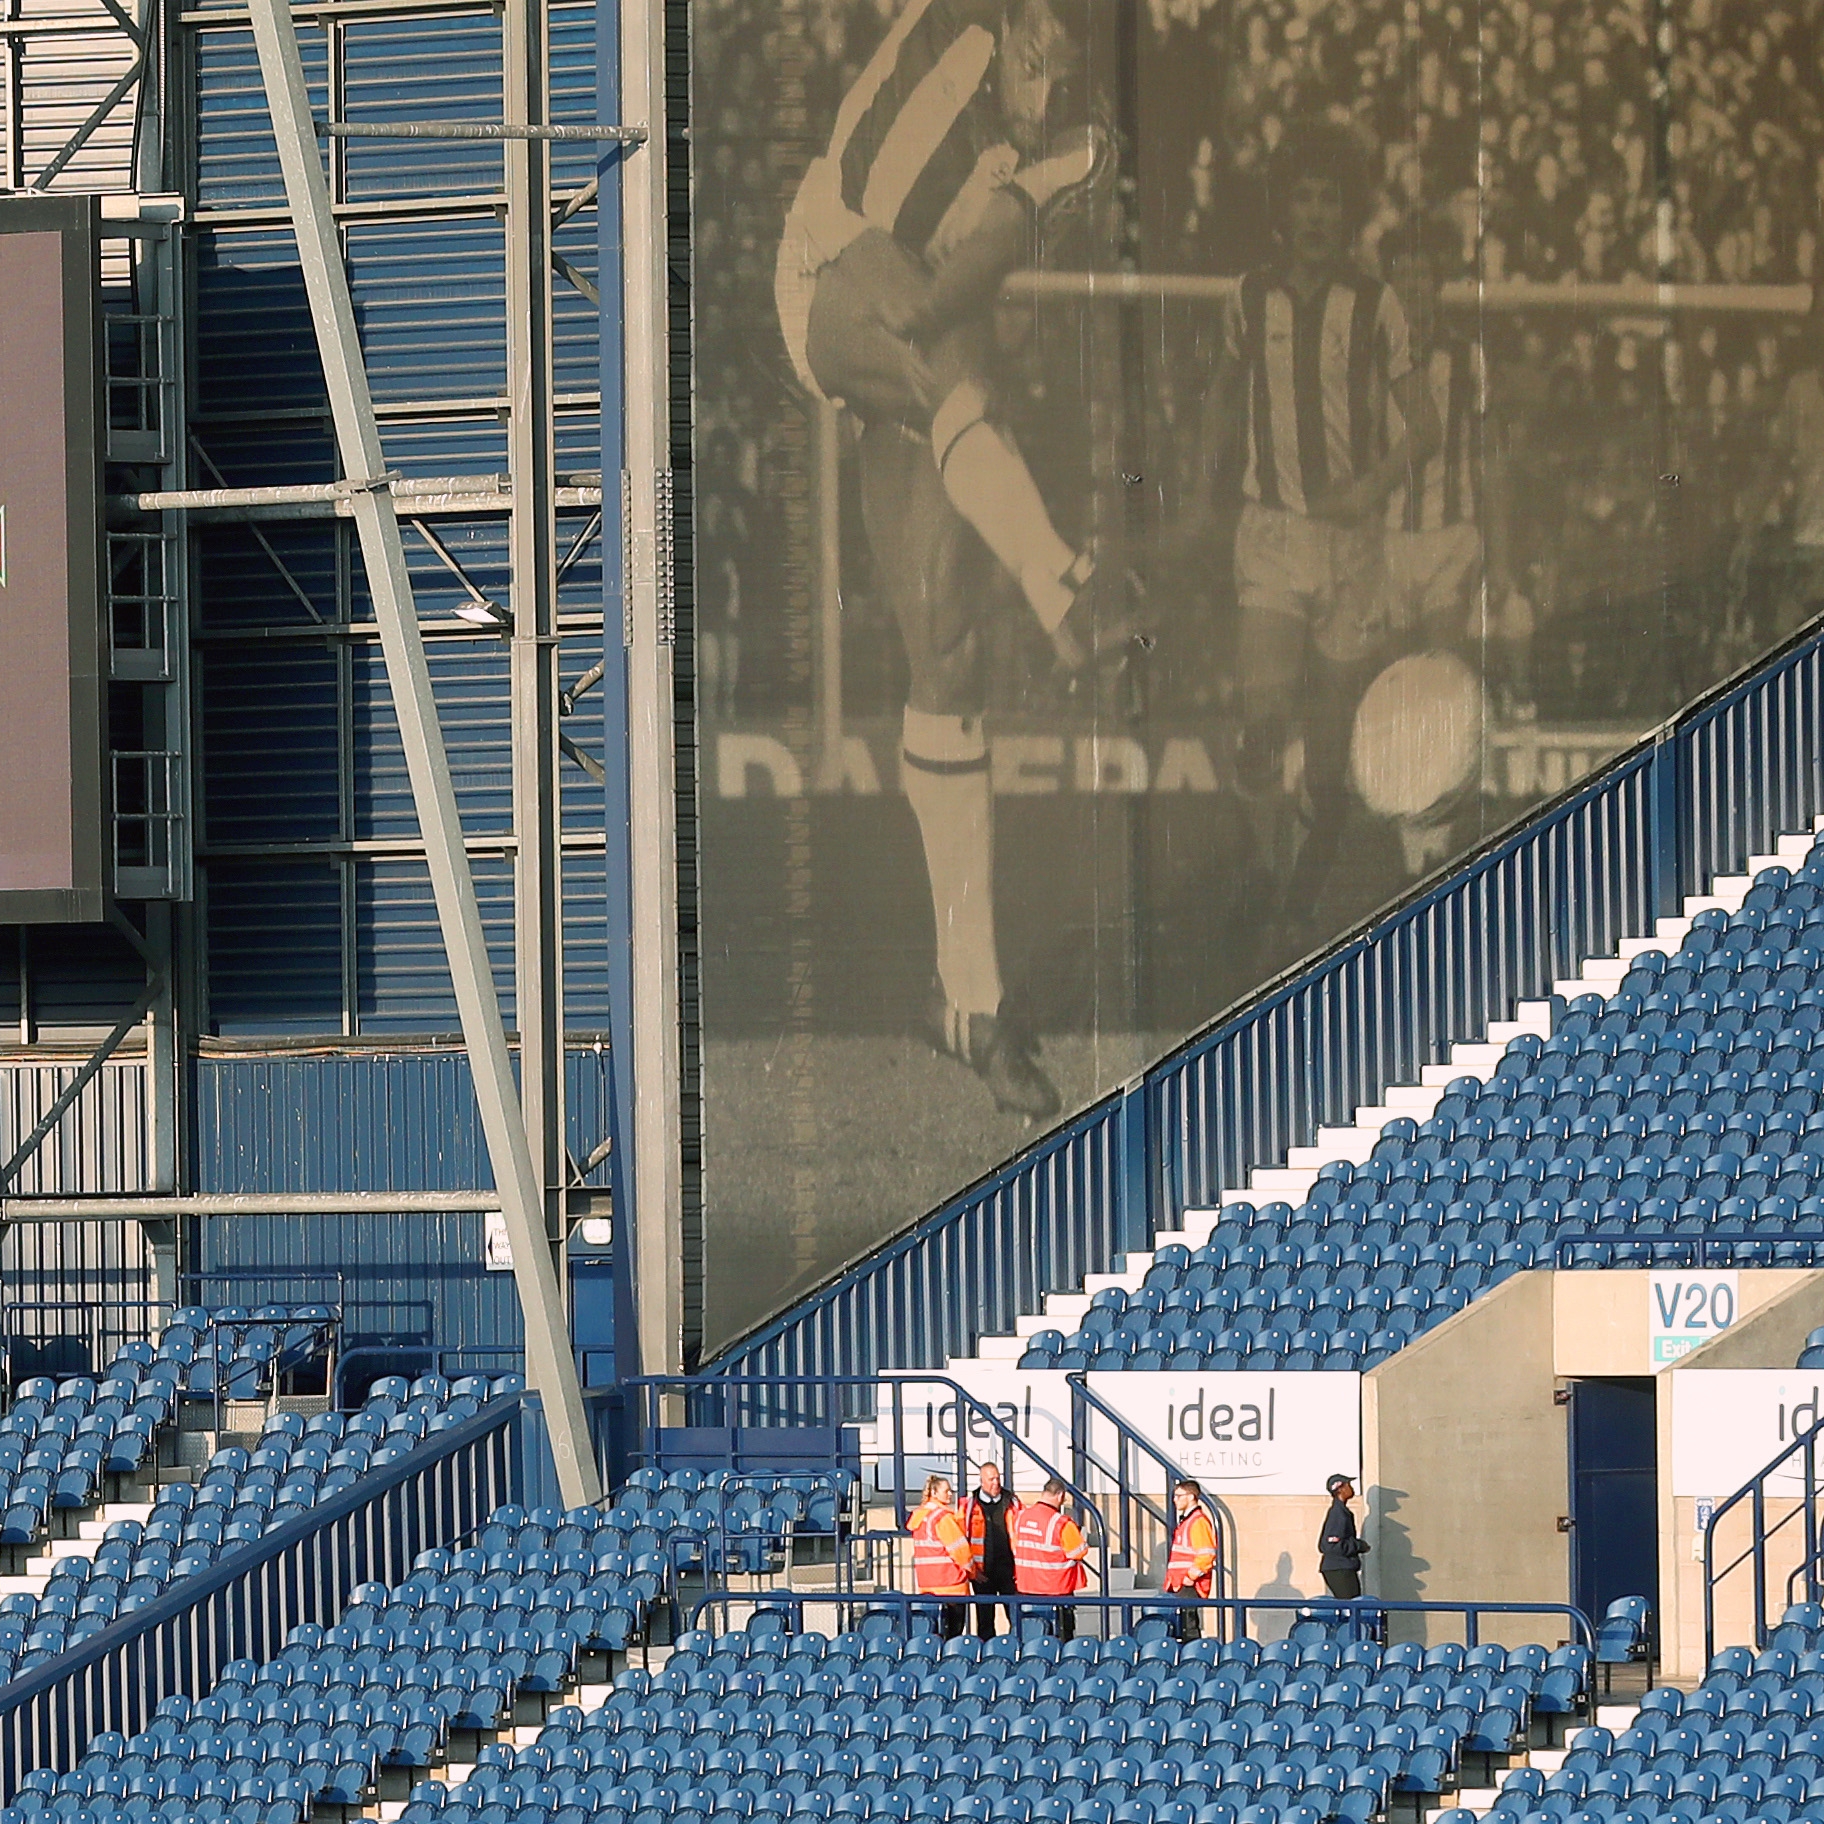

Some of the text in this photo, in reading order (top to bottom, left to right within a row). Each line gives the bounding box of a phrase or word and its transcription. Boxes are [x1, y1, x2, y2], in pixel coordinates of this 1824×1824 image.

[1654, 1282, 1734, 1330] V20
[1661, 1340, 1693, 1359] Exit
[927, 1385, 1031, 1438] ideal
[1168, 1387, 1275, 1441] ideal
[1179, 1451, 1263, 1467] HEATING
